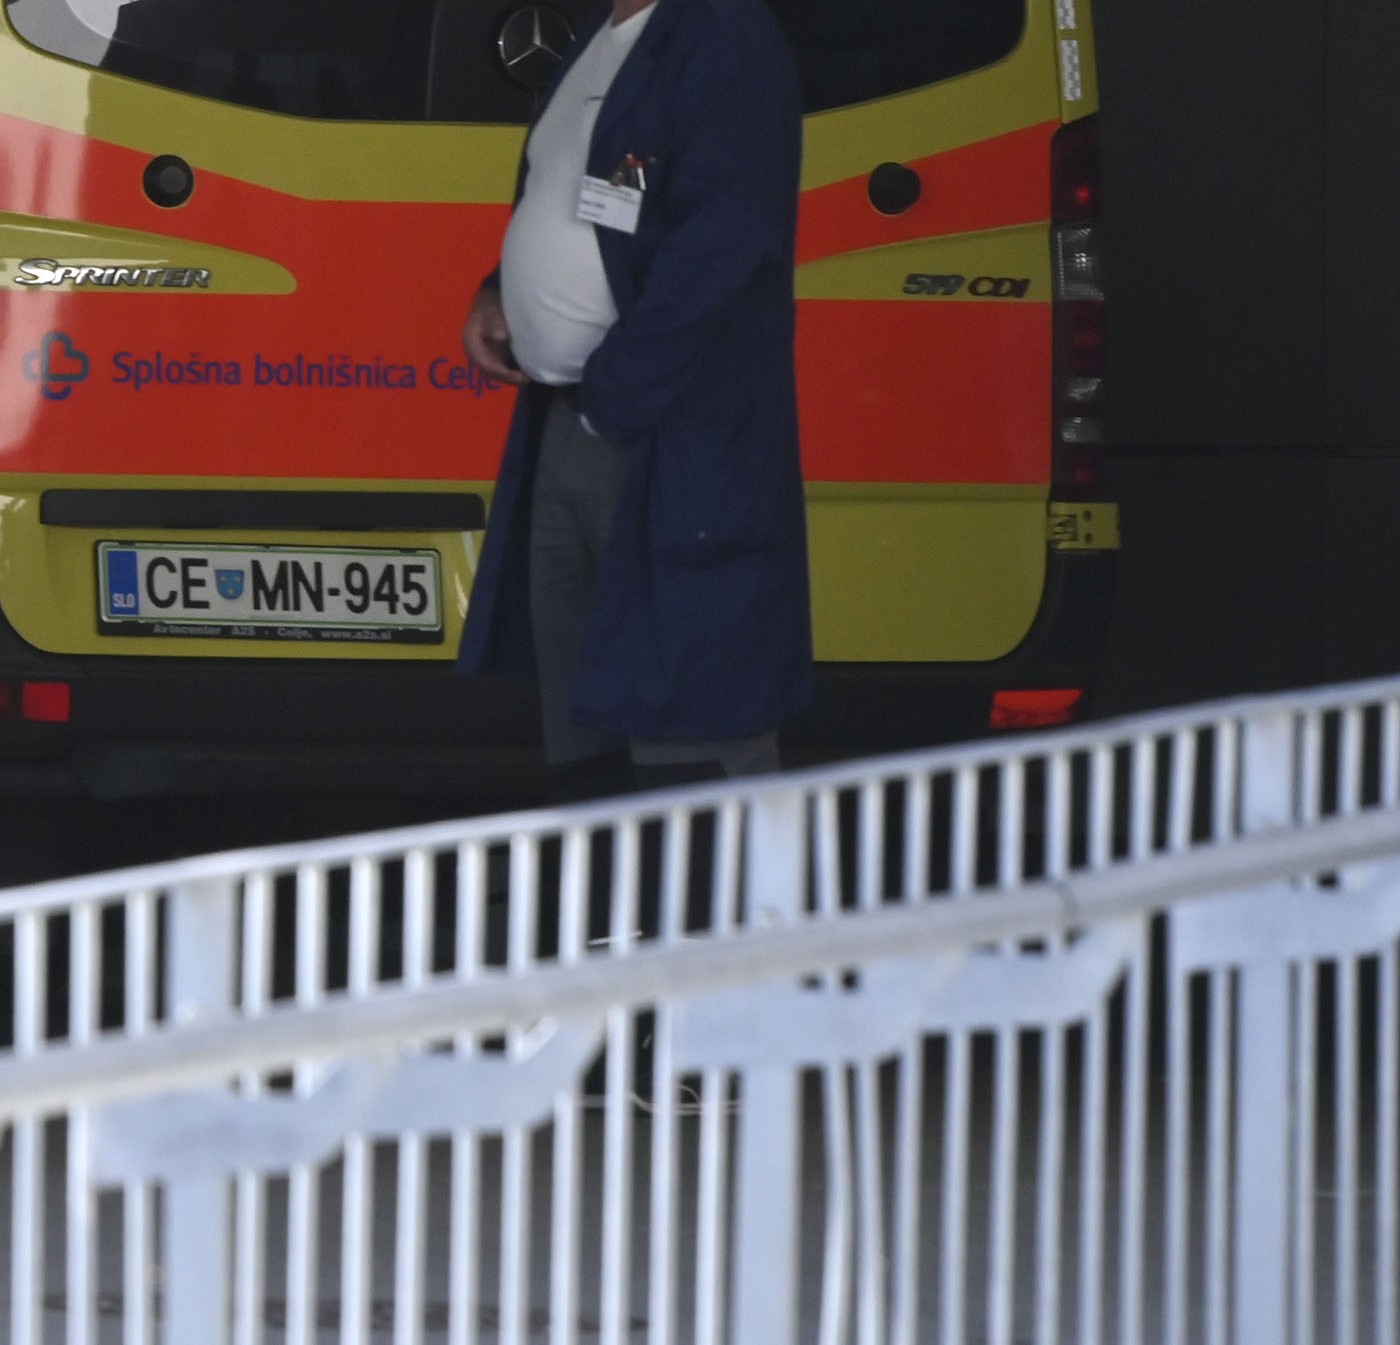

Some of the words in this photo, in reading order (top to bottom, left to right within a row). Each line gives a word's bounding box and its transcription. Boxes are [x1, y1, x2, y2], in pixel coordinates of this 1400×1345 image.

[14, 257, 211, 289] SPRINTER
[968, 276, 1031, 298] CDI
[112, 351, 242, 391] Splošna
[254, 353, 417, 390] bolnišnica
[112, 592, 136, 608] SLO
[146, 556, 210, 610] CE
[251, 559, 429, 616] MN-945
